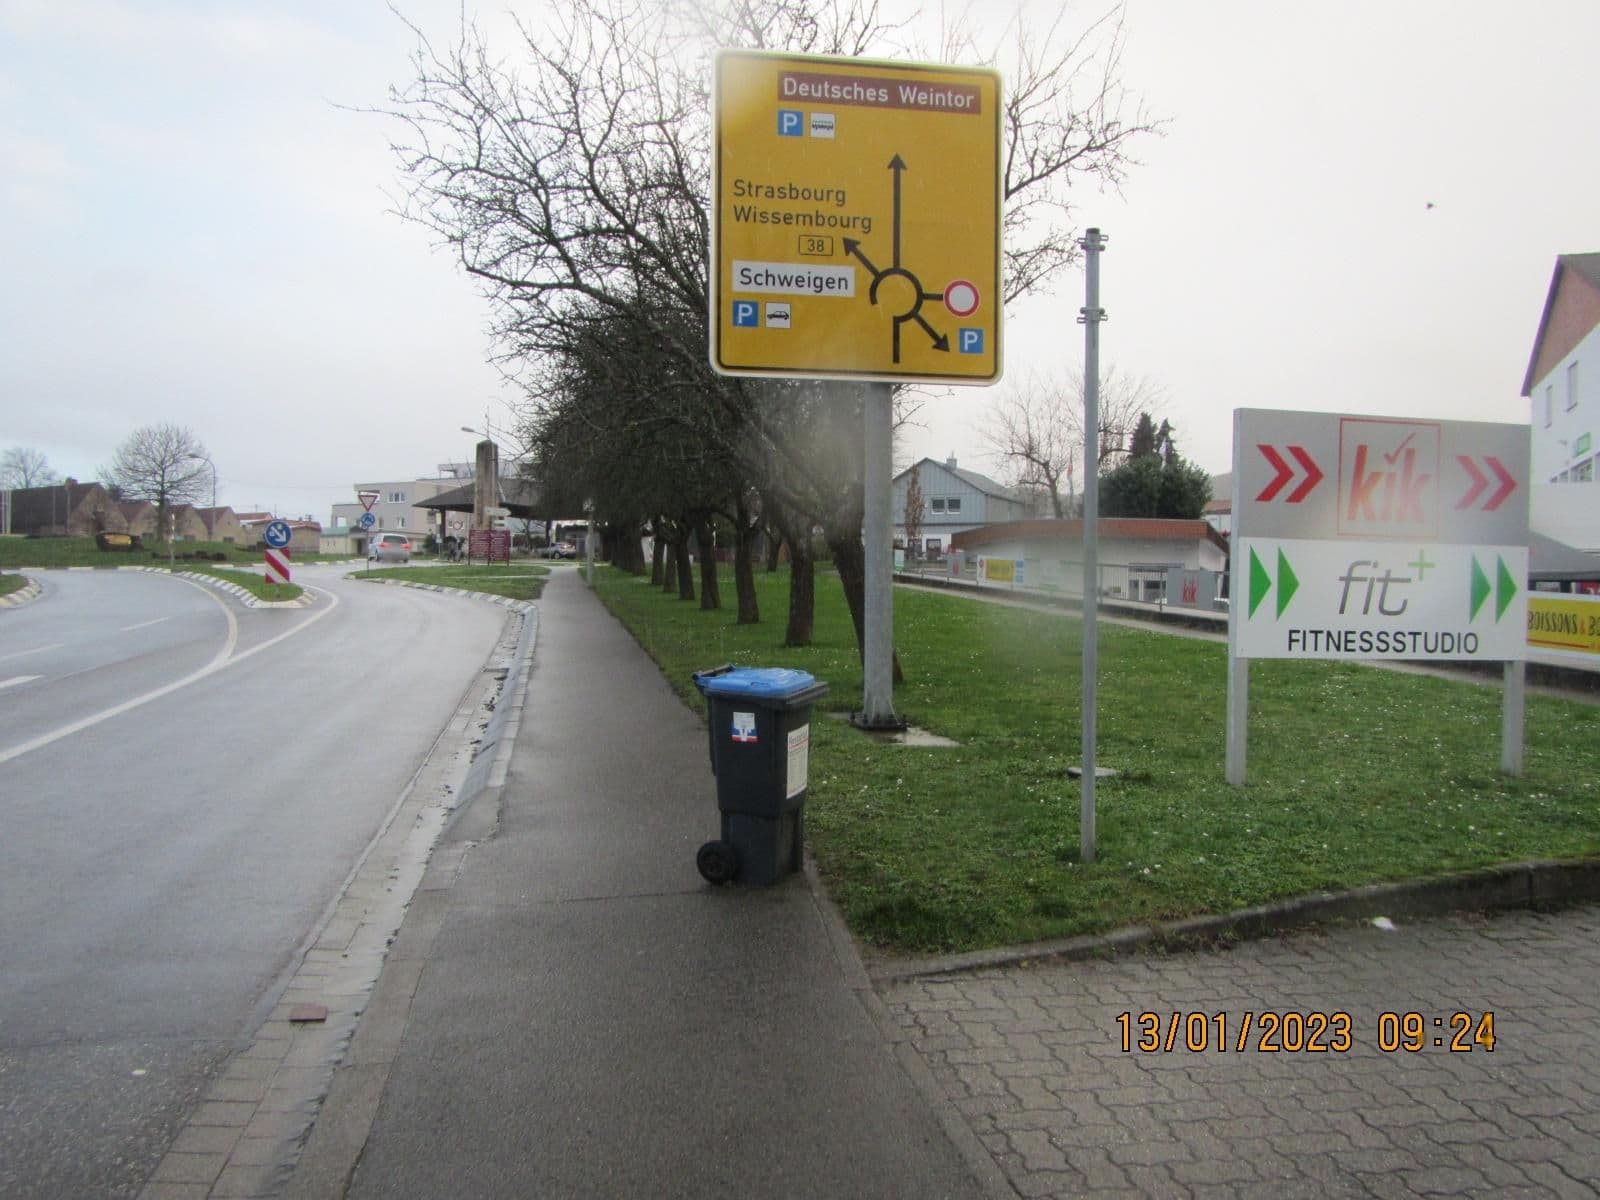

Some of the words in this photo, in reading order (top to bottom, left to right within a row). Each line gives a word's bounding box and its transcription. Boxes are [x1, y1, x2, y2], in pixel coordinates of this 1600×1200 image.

[783, 77, 889, 103] Deutsches
[898, 85, 976, 109] Weintor
[782, 112, 799, 134] P
[733, 178, 847, 208] Strasbourg
[733, 204, 873, 234] Wissembourg
[807, 238, 826, 254] 38
[739, 267, 849, 294] Schweigen
[737, 303, 754, 325] P
[962, 330, 979, 349] P
[1527, 610, 1578, 635] BOISSONS
[1287, 629, 1479, 654] FITNESSSTUDIO
